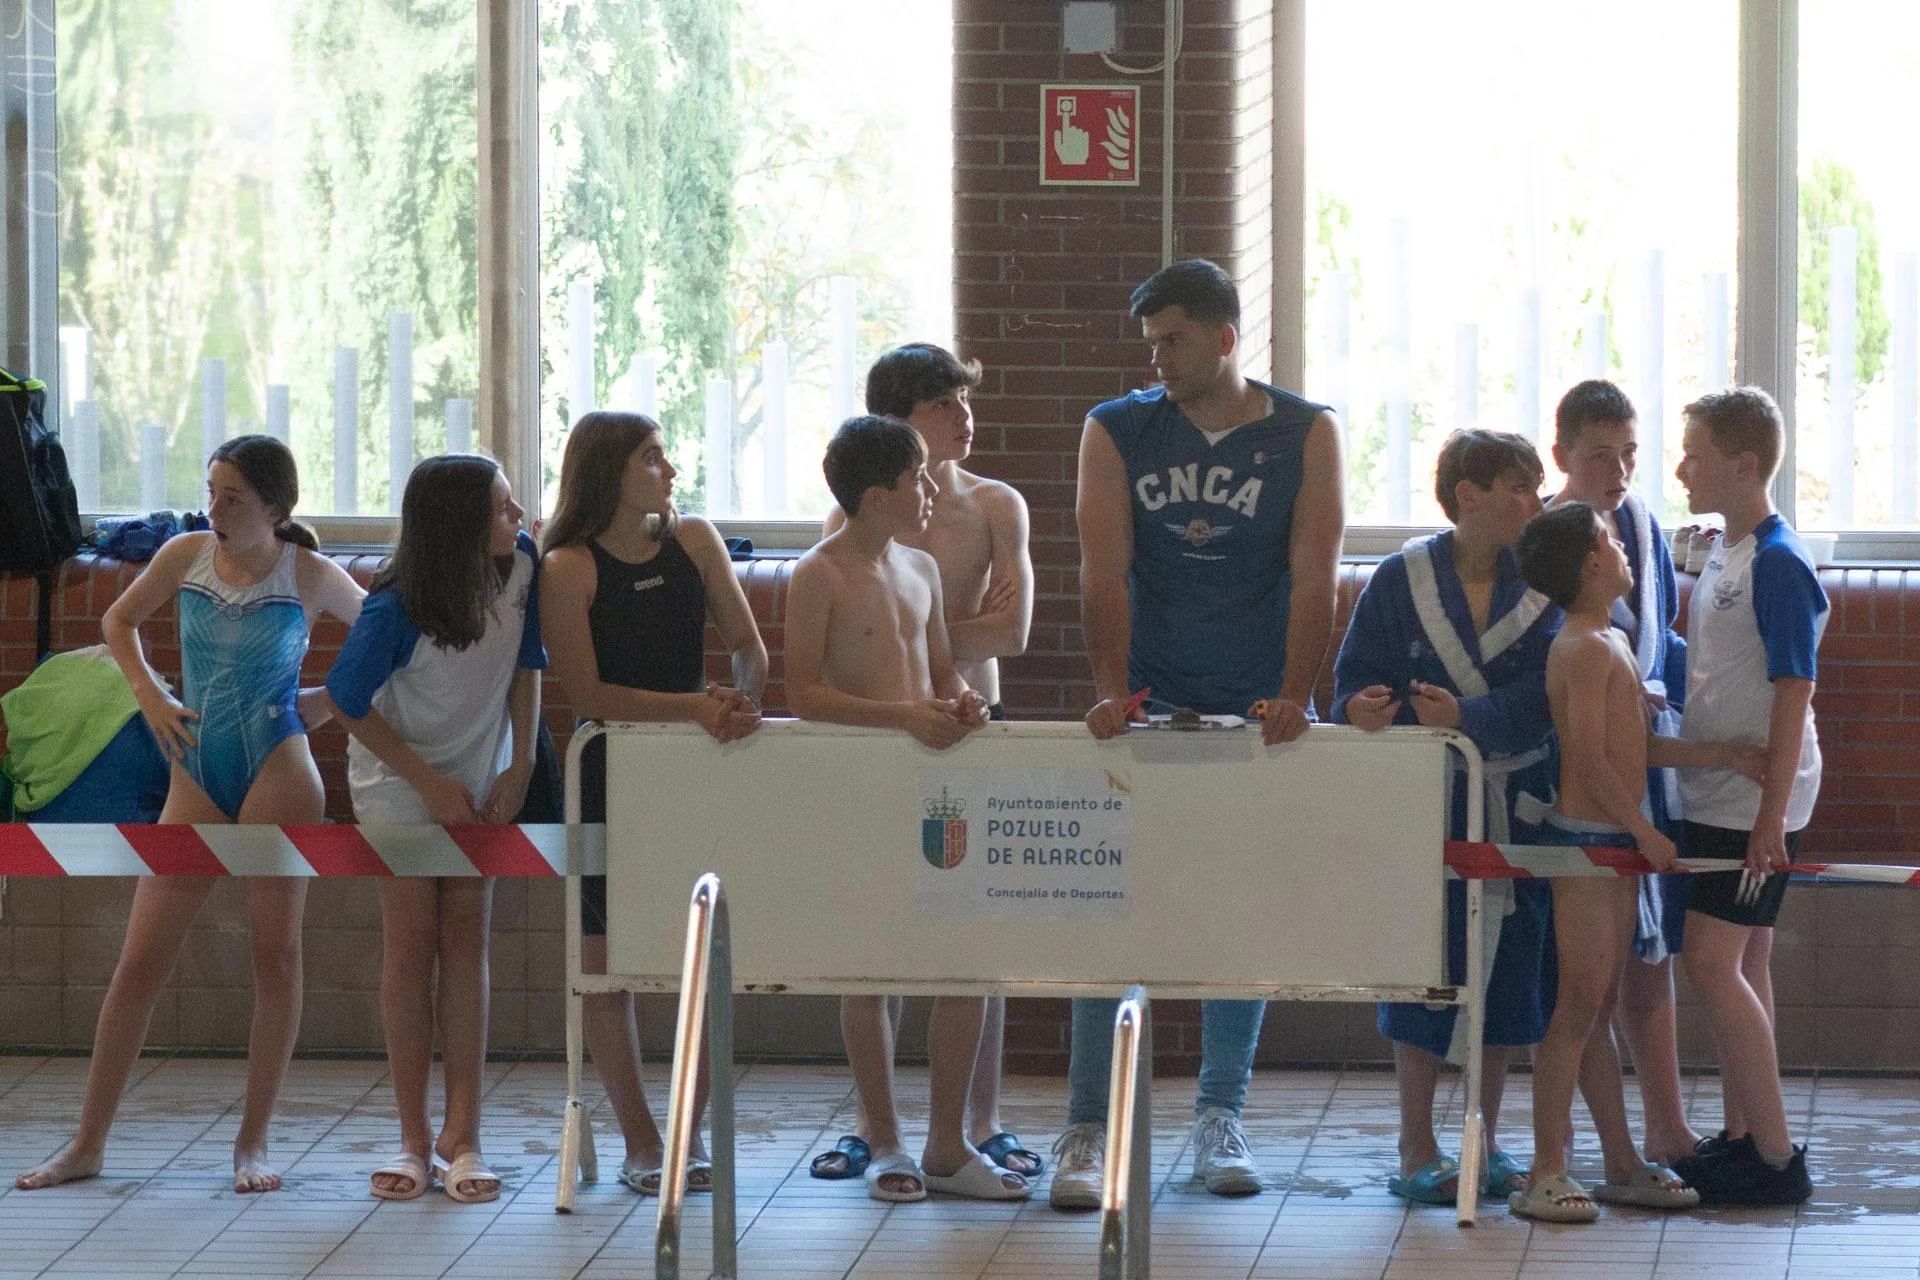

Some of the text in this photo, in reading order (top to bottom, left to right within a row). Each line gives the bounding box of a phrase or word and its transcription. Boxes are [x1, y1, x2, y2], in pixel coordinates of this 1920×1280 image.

[1135, 462, 1263, 518] CNCA
[987, 797, 1122, 812] Ayuntamiento de
[987, 820, 1081, 837] POZUELO
[987, 841, 1122, 866] DE ALARCÓN
[1052, 888, 1067, 899] de
[1070, 888, 1124, 901] Deportes
